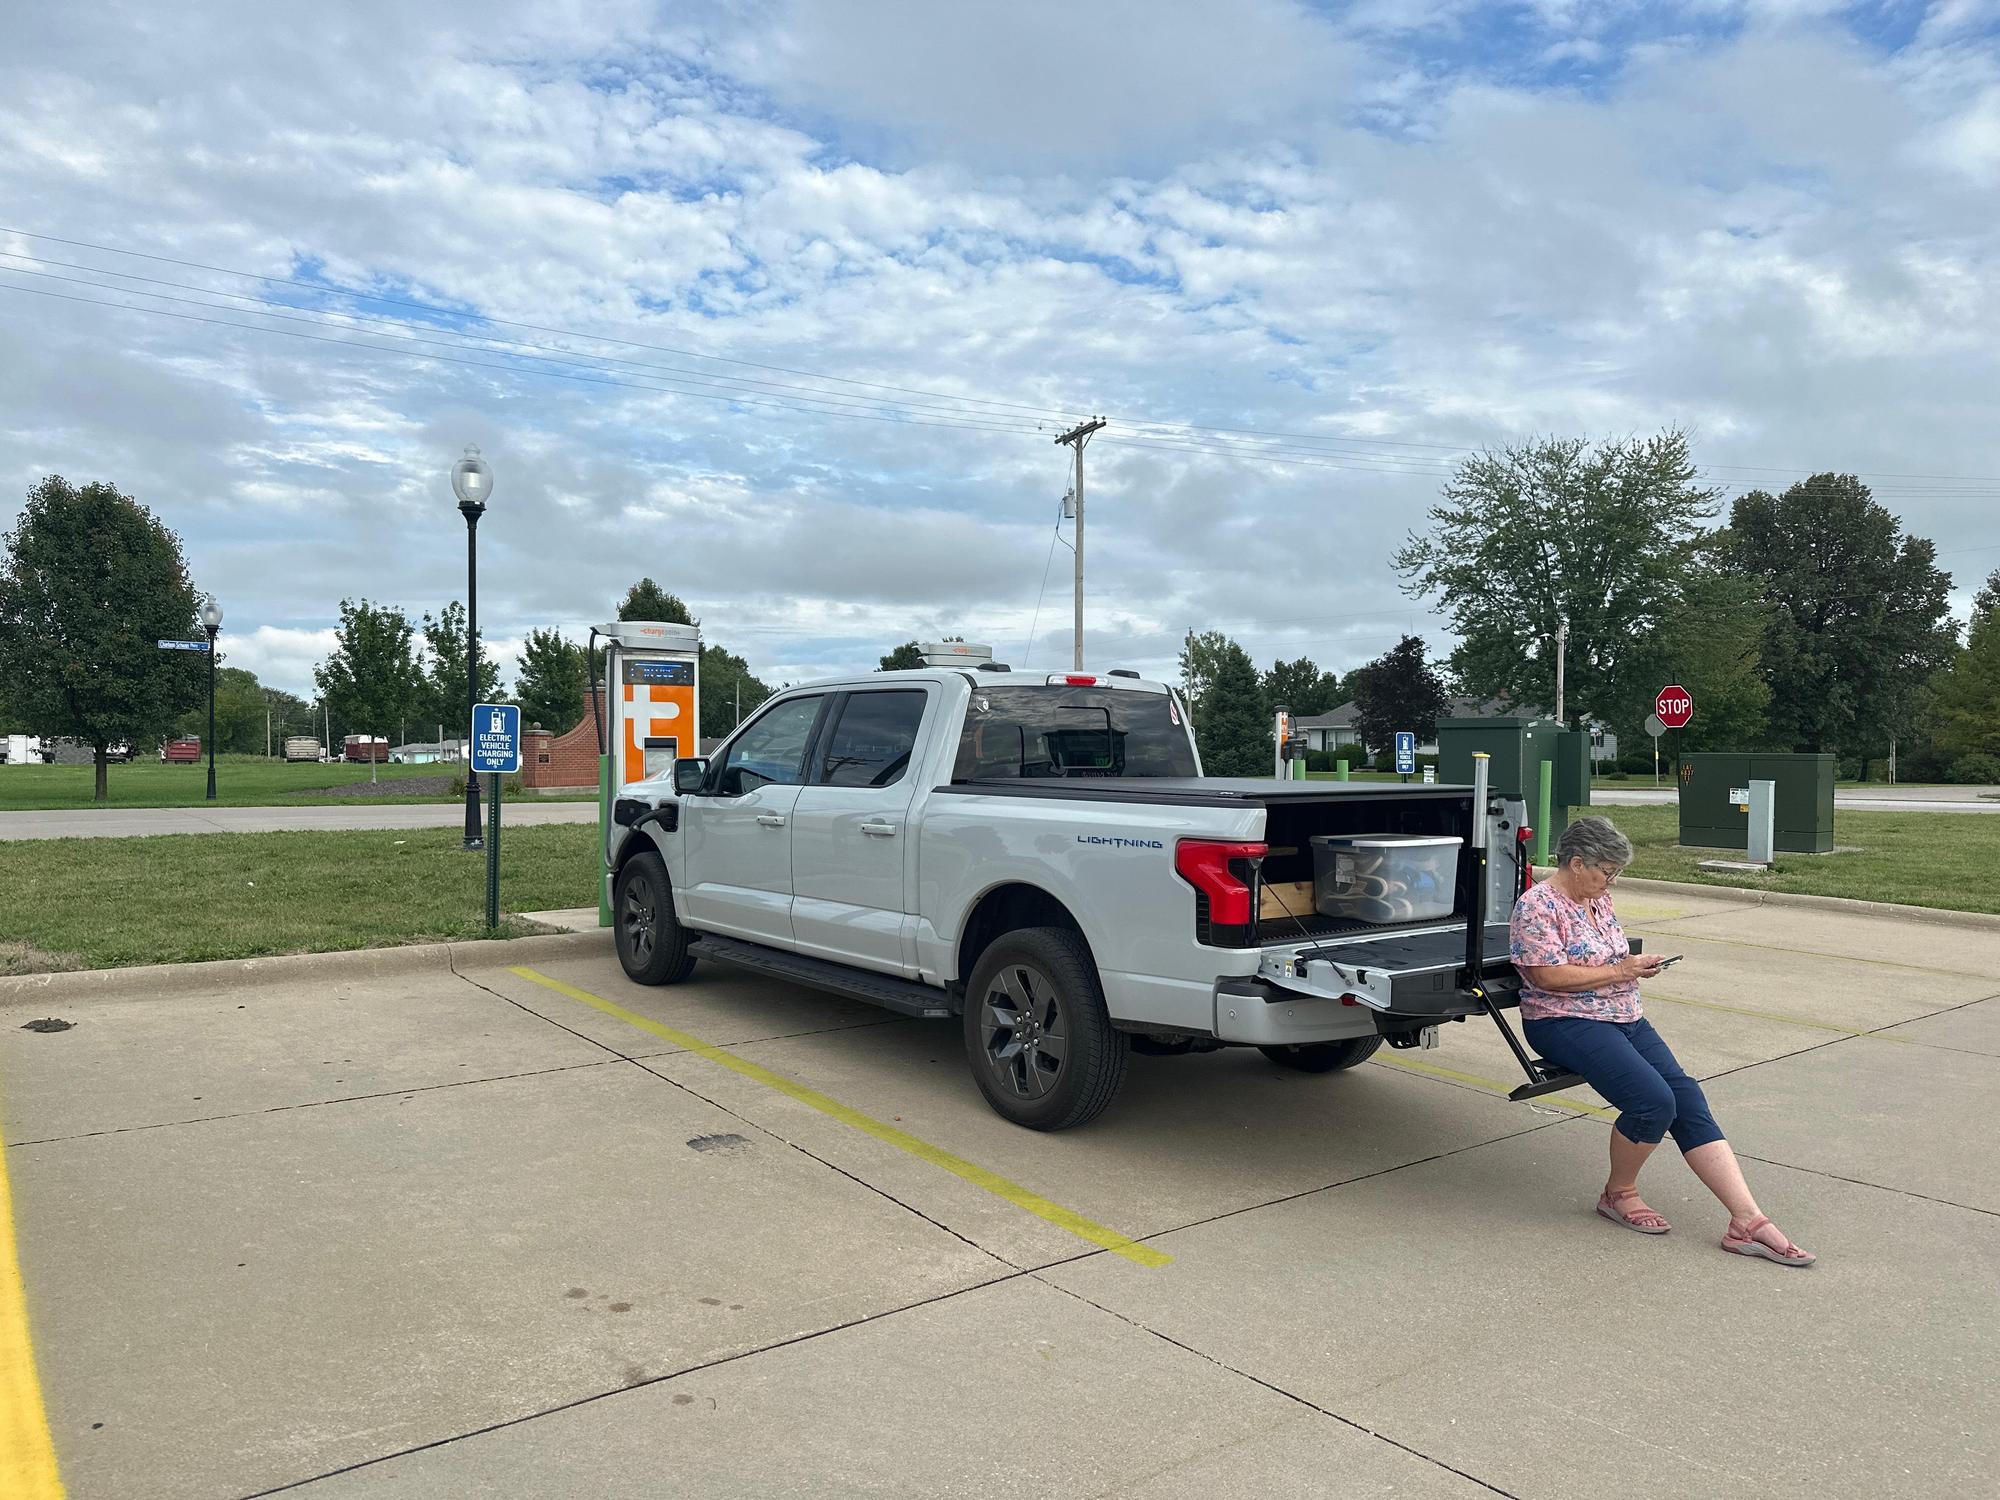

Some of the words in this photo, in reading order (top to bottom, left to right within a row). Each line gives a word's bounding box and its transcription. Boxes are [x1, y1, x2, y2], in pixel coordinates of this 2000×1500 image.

[1659, 699, 1690, 715] STOP
[479, 733, 512, 742] ELECTRIC
[481, 742, 510, 750] VEHICLE
[477, 750, 513, 758] CHARGING
[486, 758, 505, 766] ONLY
[1077, 835, 1163, 849] LIGHTNING
